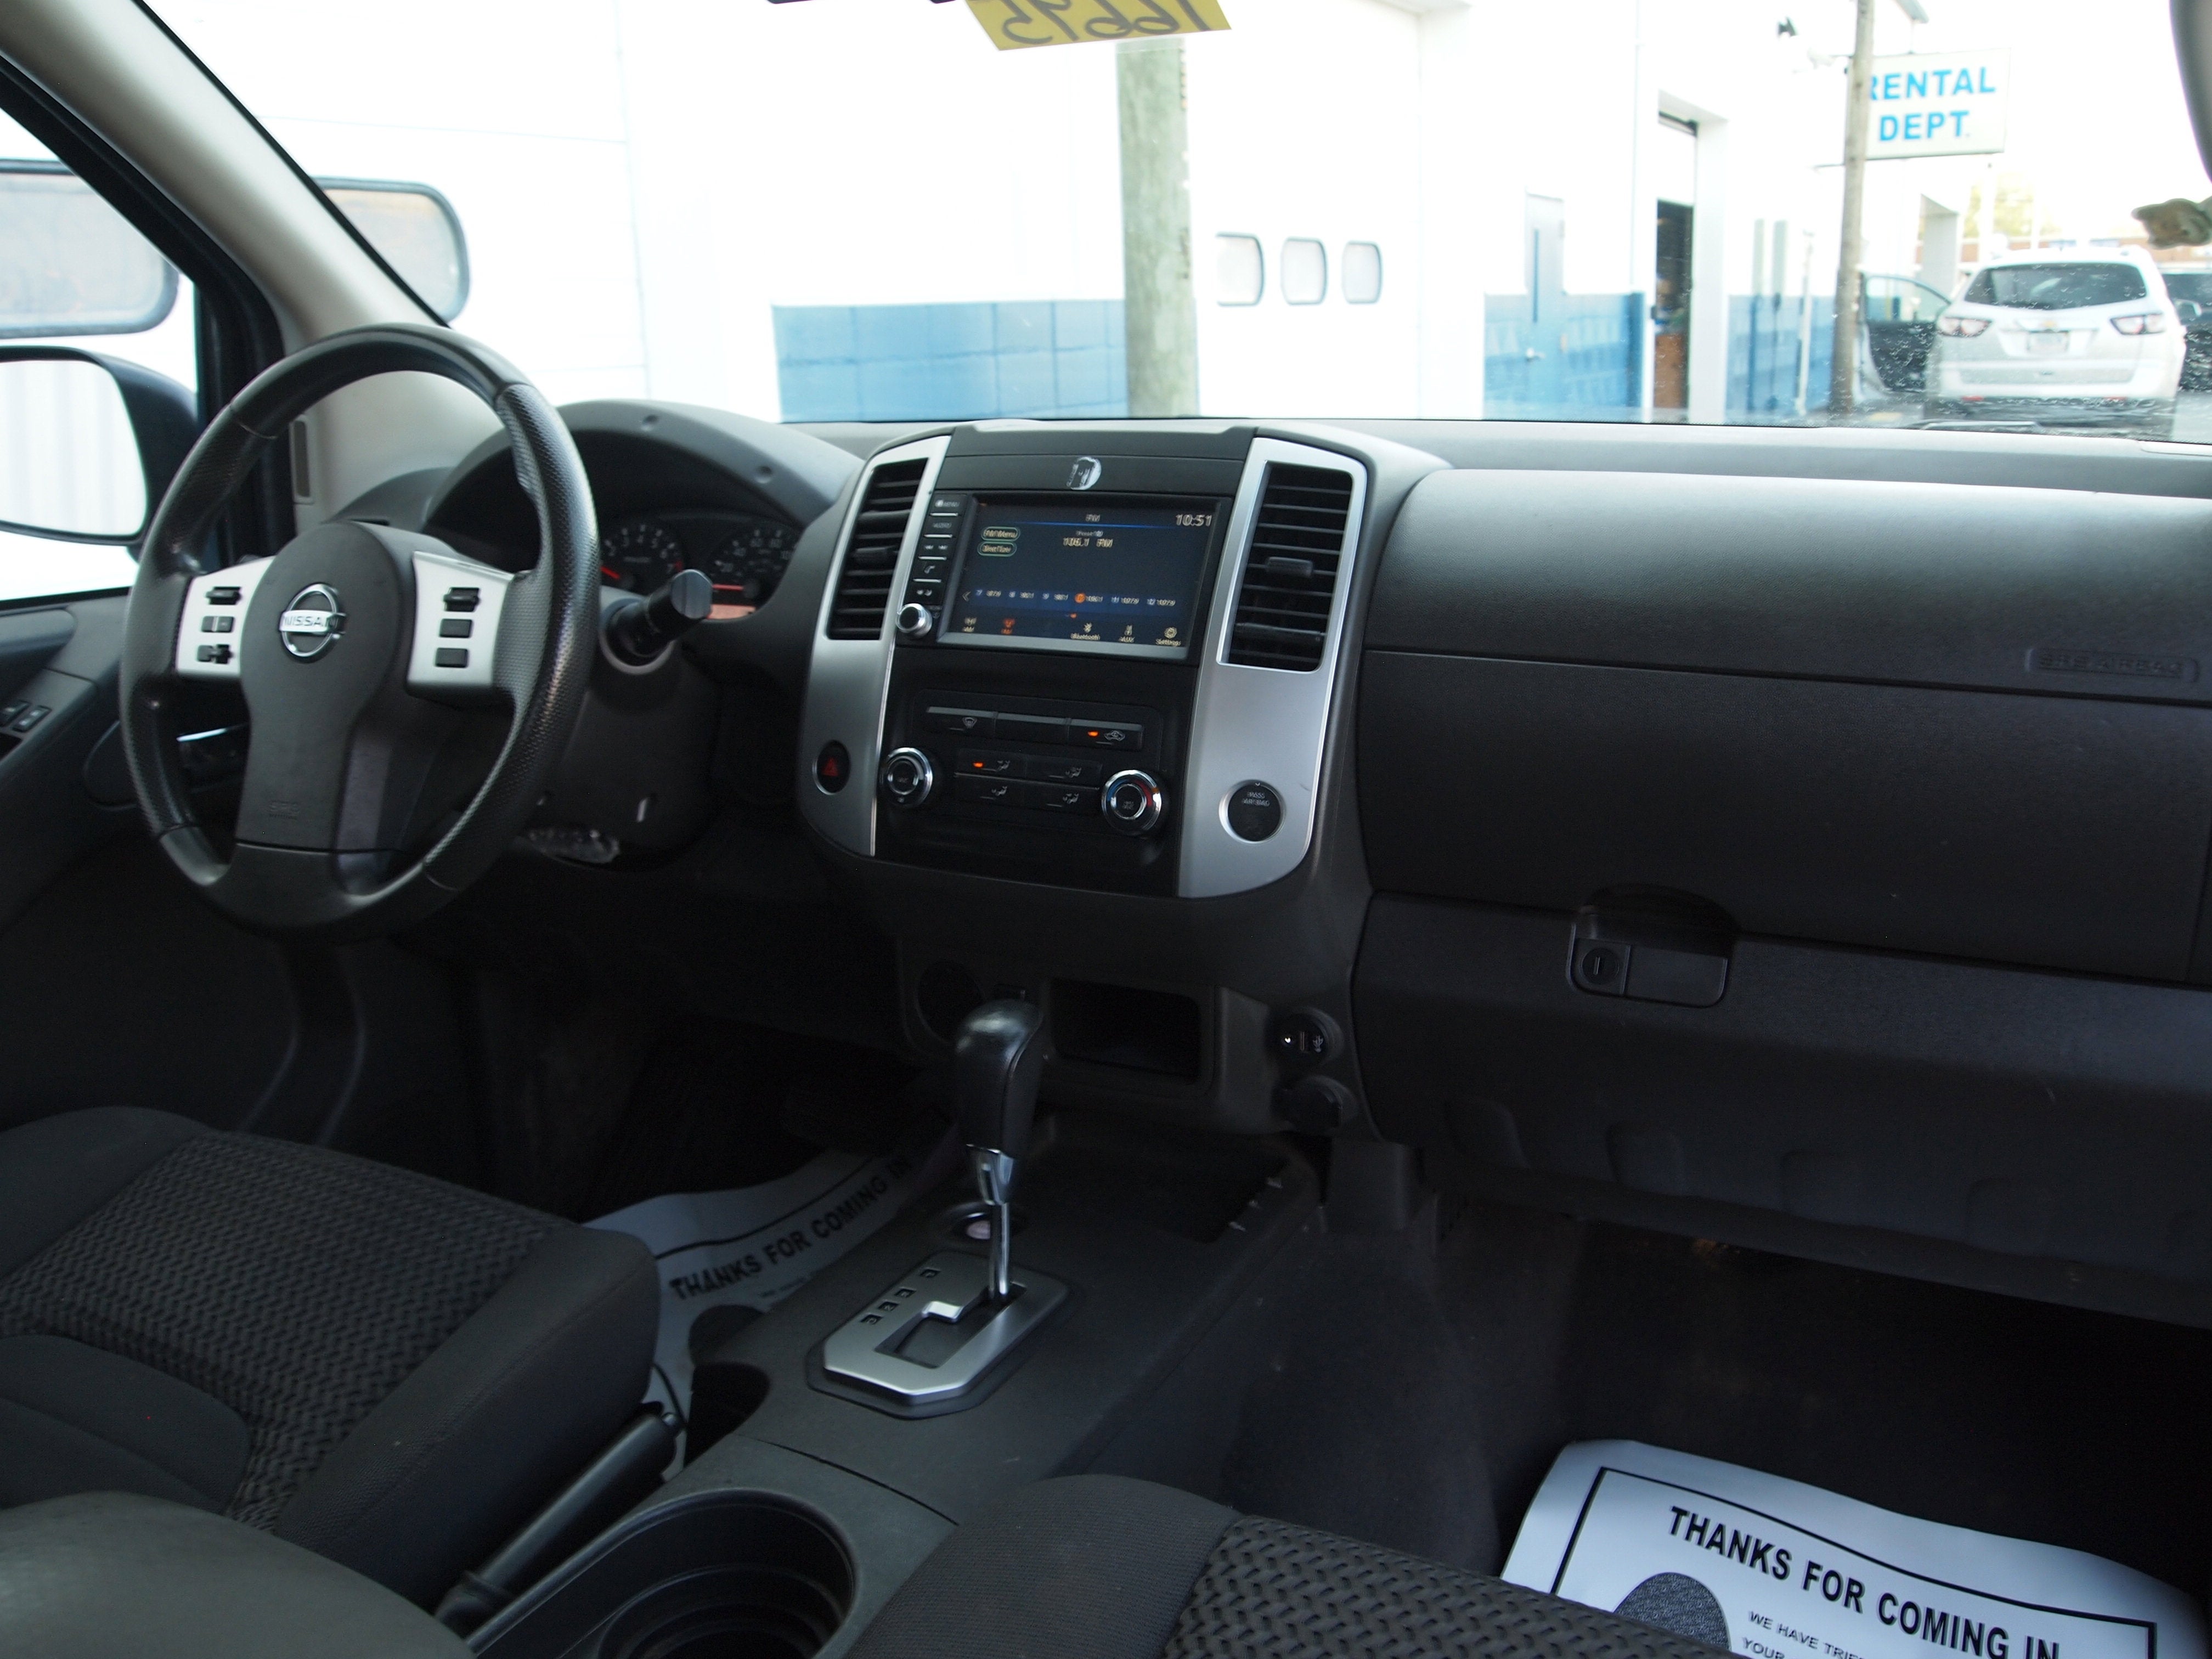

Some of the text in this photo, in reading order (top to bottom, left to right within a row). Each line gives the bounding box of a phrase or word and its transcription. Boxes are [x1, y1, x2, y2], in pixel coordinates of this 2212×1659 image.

[1176, 514, 1212, 527] 10:51
[285, 616, 339, 628] NISSAN
[1155, 639, 1181, 647] Settings
[669, 1254, 762, 1300] THANKS
[763, 1230, 811, 1265] FOR
[811, 1176, 888, 1238] COMING
[1670, 1505, 1792, 1581] THANKS
[1802, 1560, 1866, 1614] FOR
[1877, 1593, 2009, 1659] COMING
[1748, 1611, 1865, 1659] WE HAVE TRIE
[1743, 1637, 1785, 1659] YOUR
